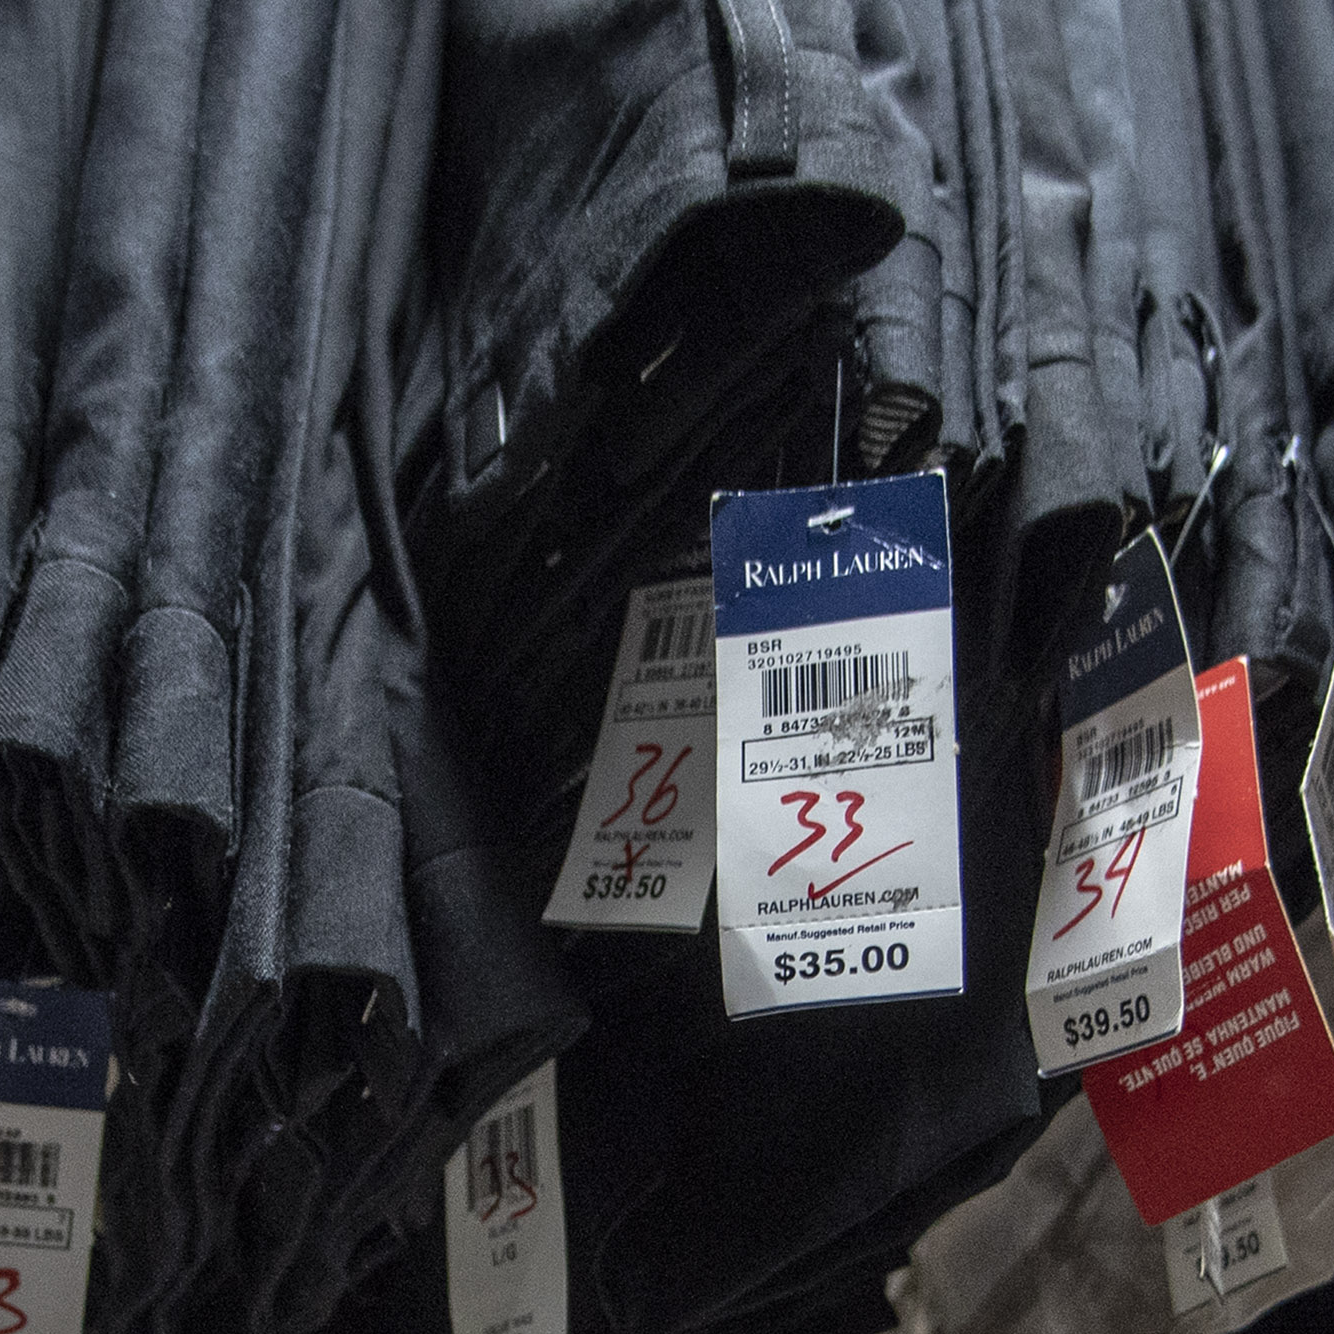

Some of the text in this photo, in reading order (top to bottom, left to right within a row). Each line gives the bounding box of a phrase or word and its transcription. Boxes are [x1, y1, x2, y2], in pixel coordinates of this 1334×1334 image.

[744, 545, 924, 589] RALPH LAUREN
[747, 643, 863, 671] 320102719495
[748, 638, 783, 656] BSR
[763, 723, 773, 736] 8
[896, 741, 926, 758] LBS
[1151, 799, 1175, 819] LBS
[767, 790, 866, 877] 33
[582, 873, 668, 901] $39.50
[1051, 826, 1148, 942] 34
[1232, 922, 1268, 954] UND
[773, 942, 911, 986] $35.00
[1046, 936, 1153, 983] RALPHLAUREN.COM
[1063, 994, 1151, 1048] $39.50
[1182, 1035, 1204, 1061] SE
